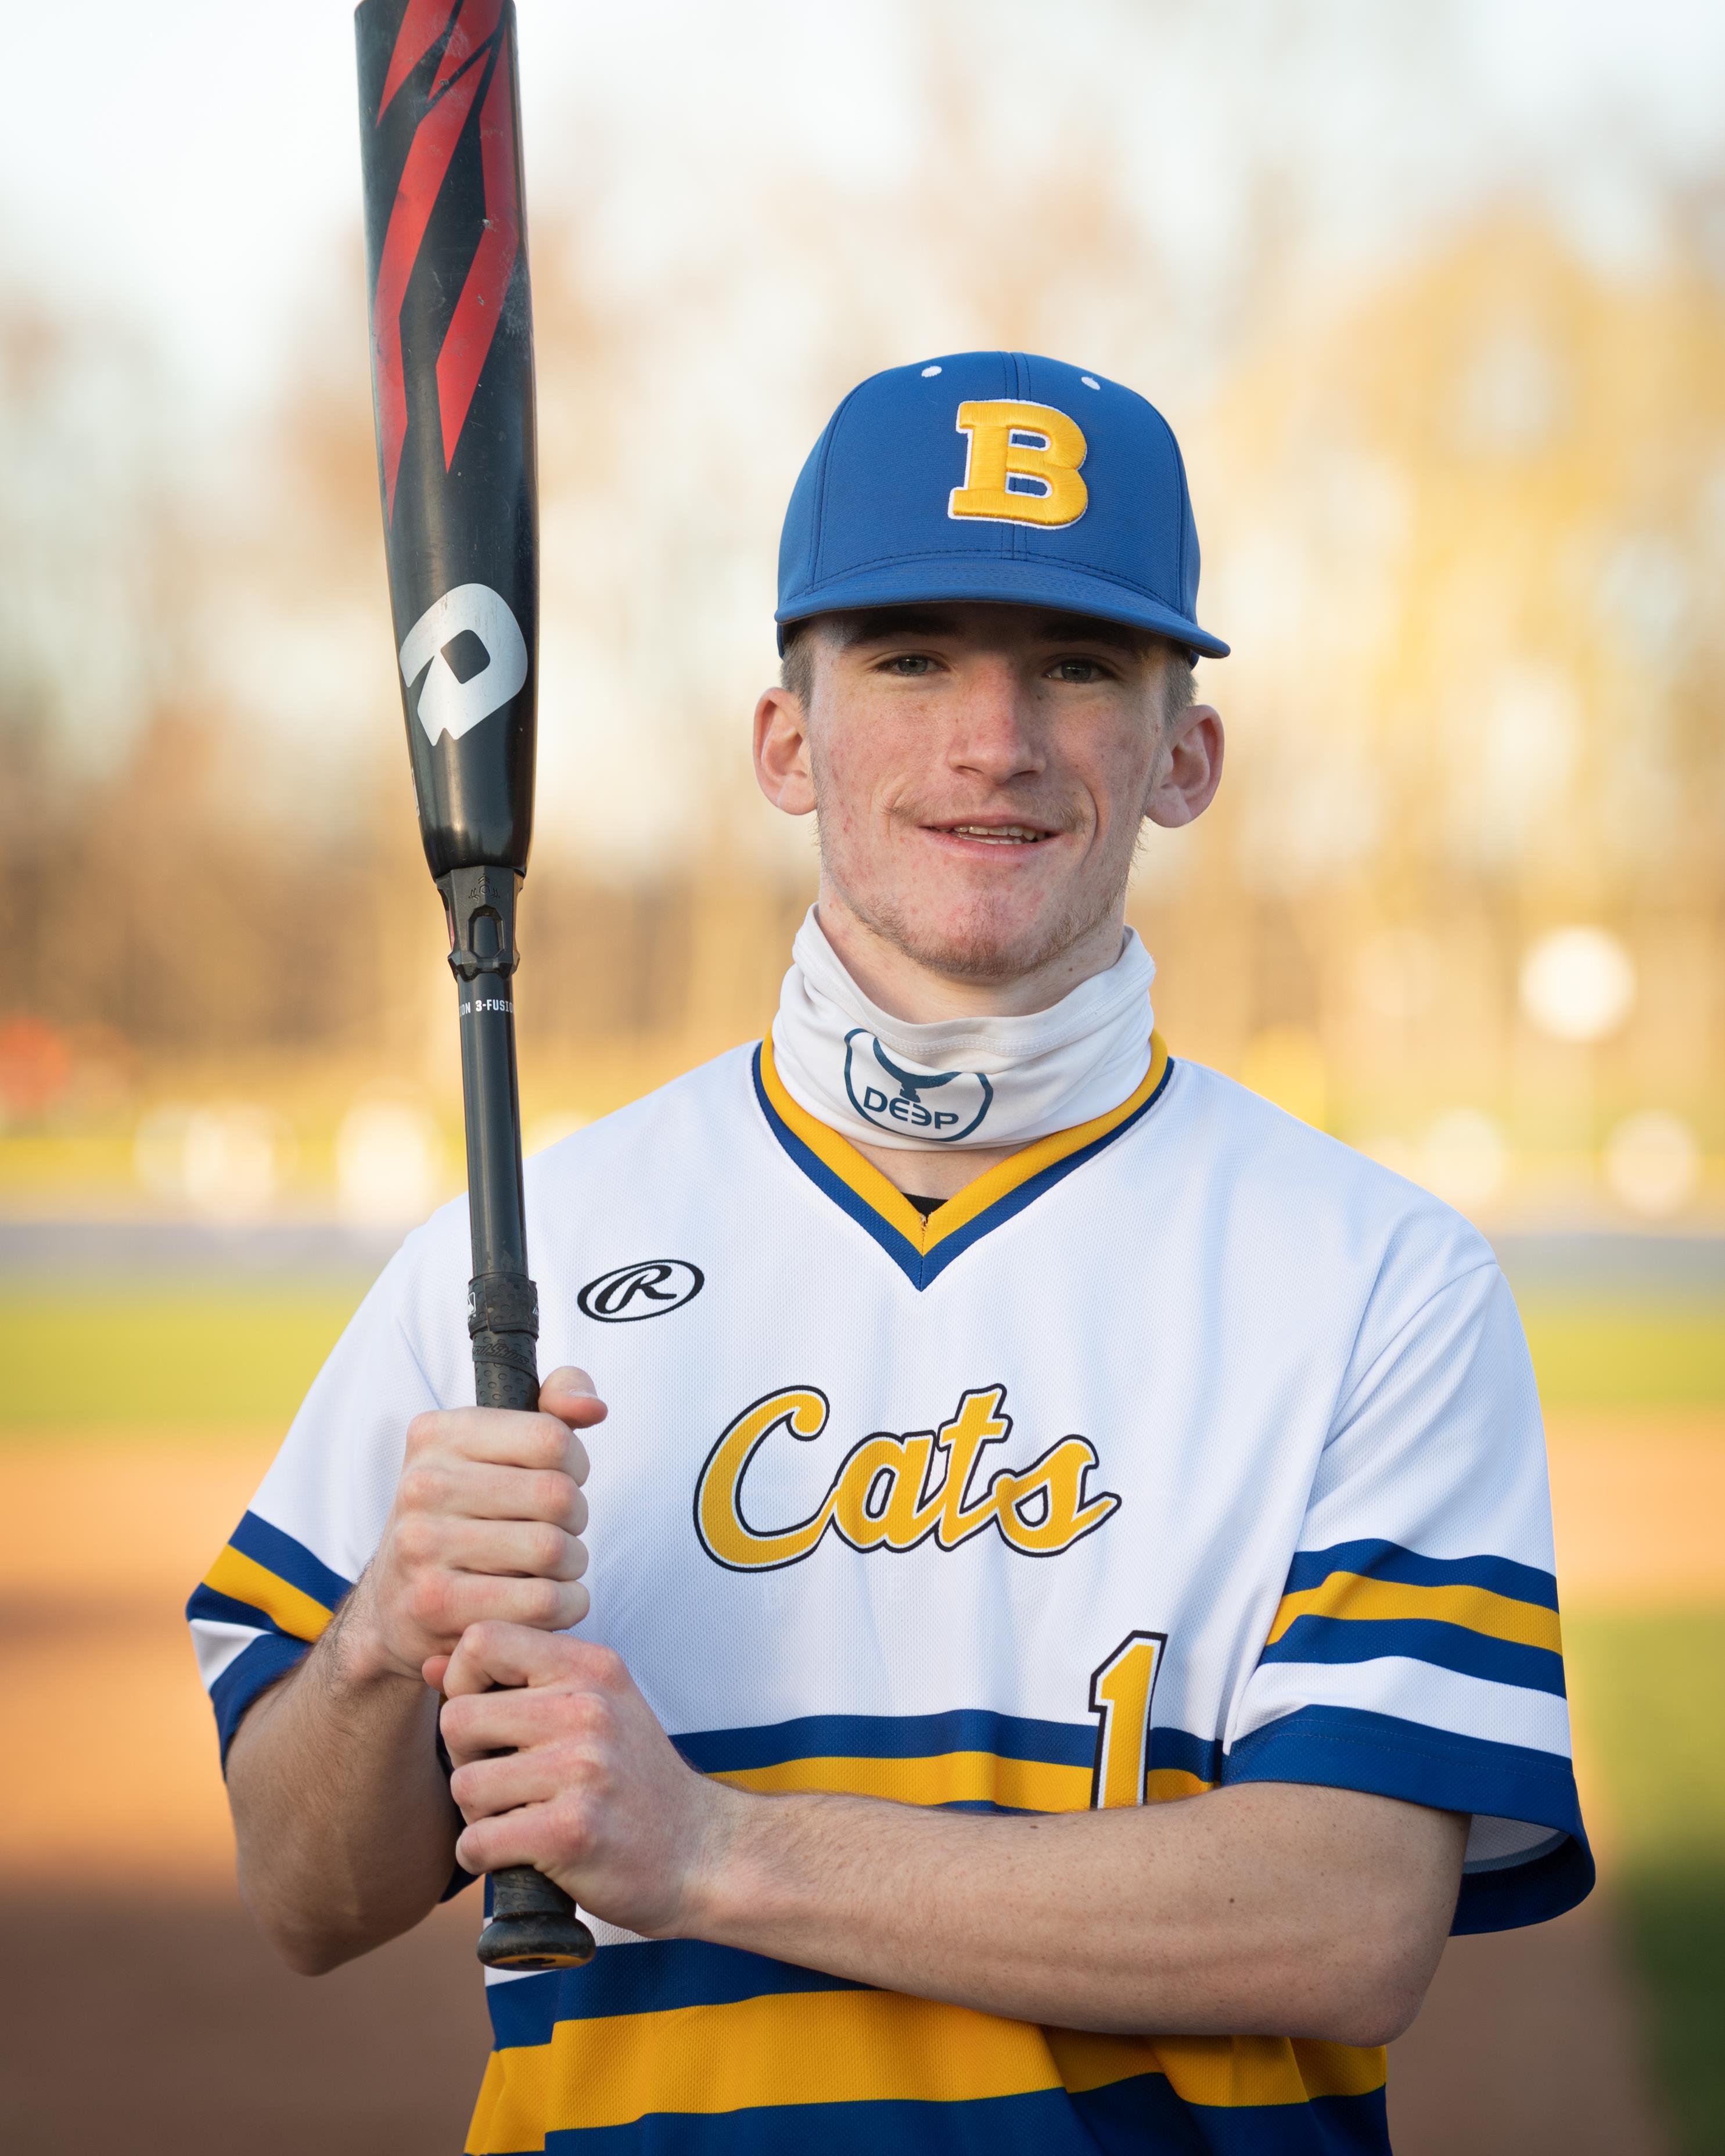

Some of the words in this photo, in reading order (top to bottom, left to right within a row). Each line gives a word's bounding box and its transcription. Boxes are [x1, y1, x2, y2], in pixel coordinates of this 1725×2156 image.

[947, 398, 1088, 530] B
[863, 1086, 959, 1130] DEEP
[594, 1264, 677, 1314] R
[693, 1383, 1122, 1573] Cats
[1088, 1630, 1169, 1809] 1
